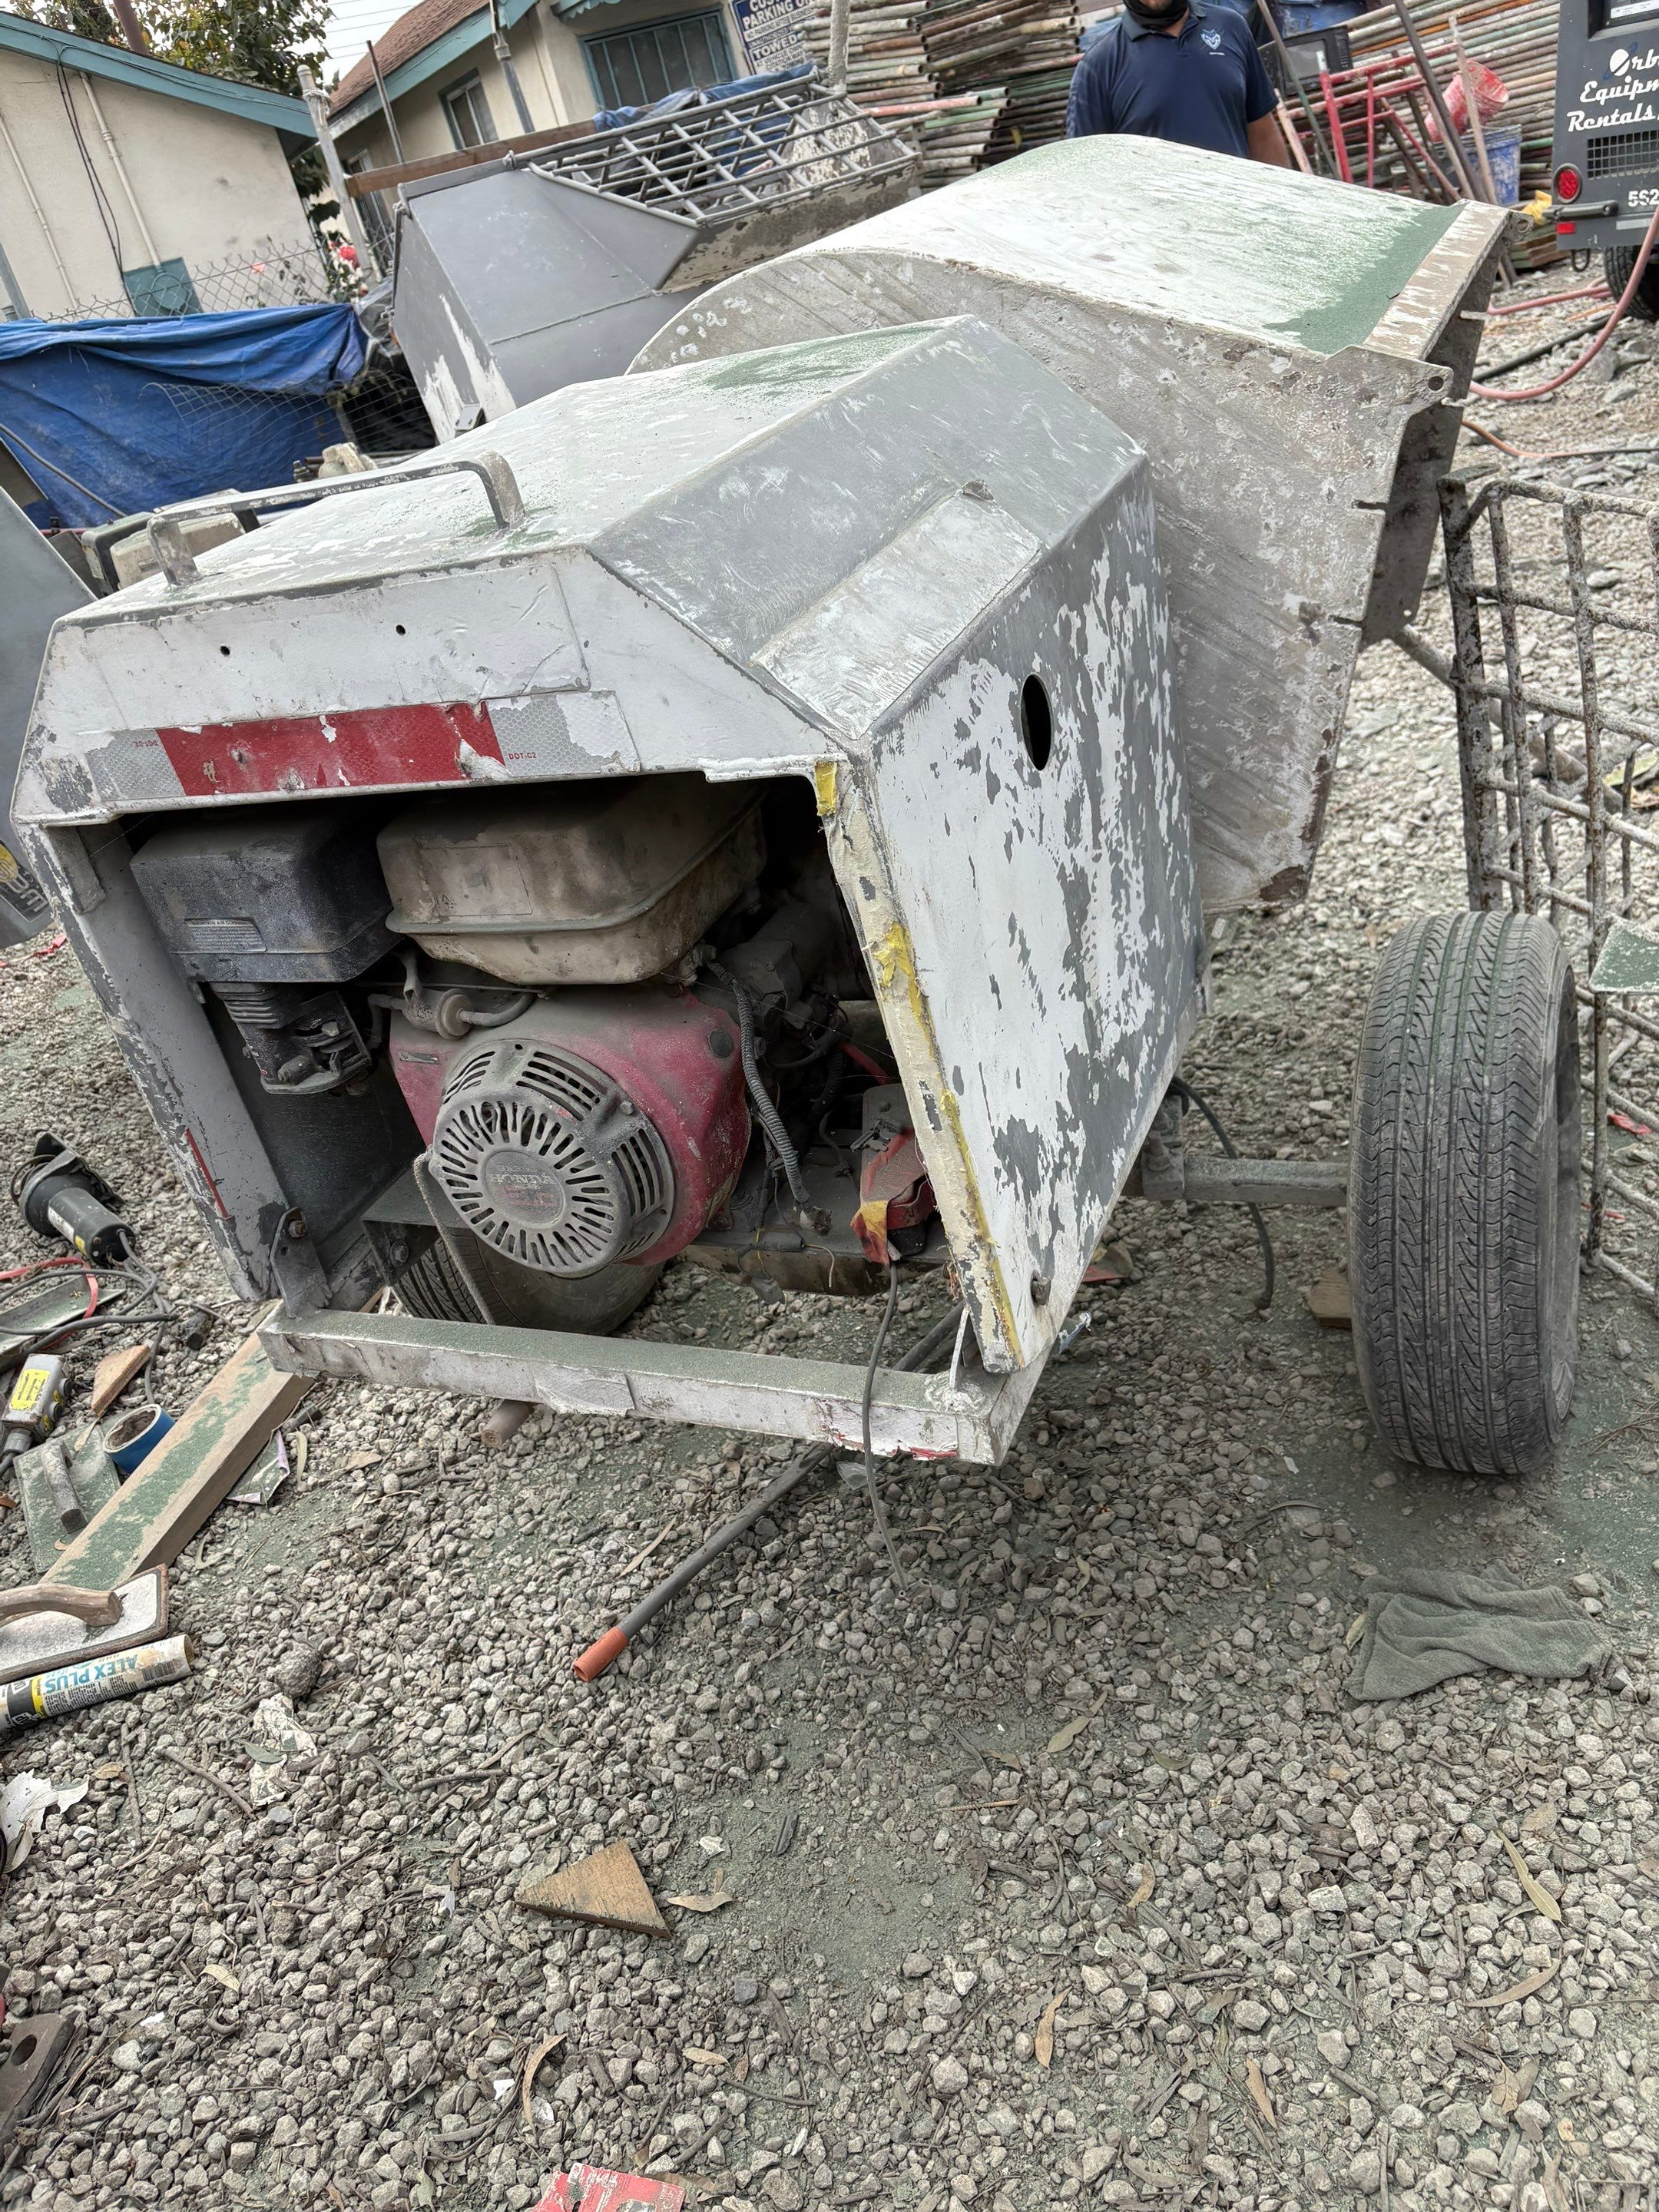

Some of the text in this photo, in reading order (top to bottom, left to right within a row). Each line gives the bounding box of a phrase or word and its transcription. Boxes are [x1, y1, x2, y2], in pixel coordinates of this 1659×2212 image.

[742, 1, 794, 30] PARKING
[753, 35, 797, 61] TOWED
[93, 1654, 138, 1678] ALEX
[45, 1671, 91, 1694] PLUS
